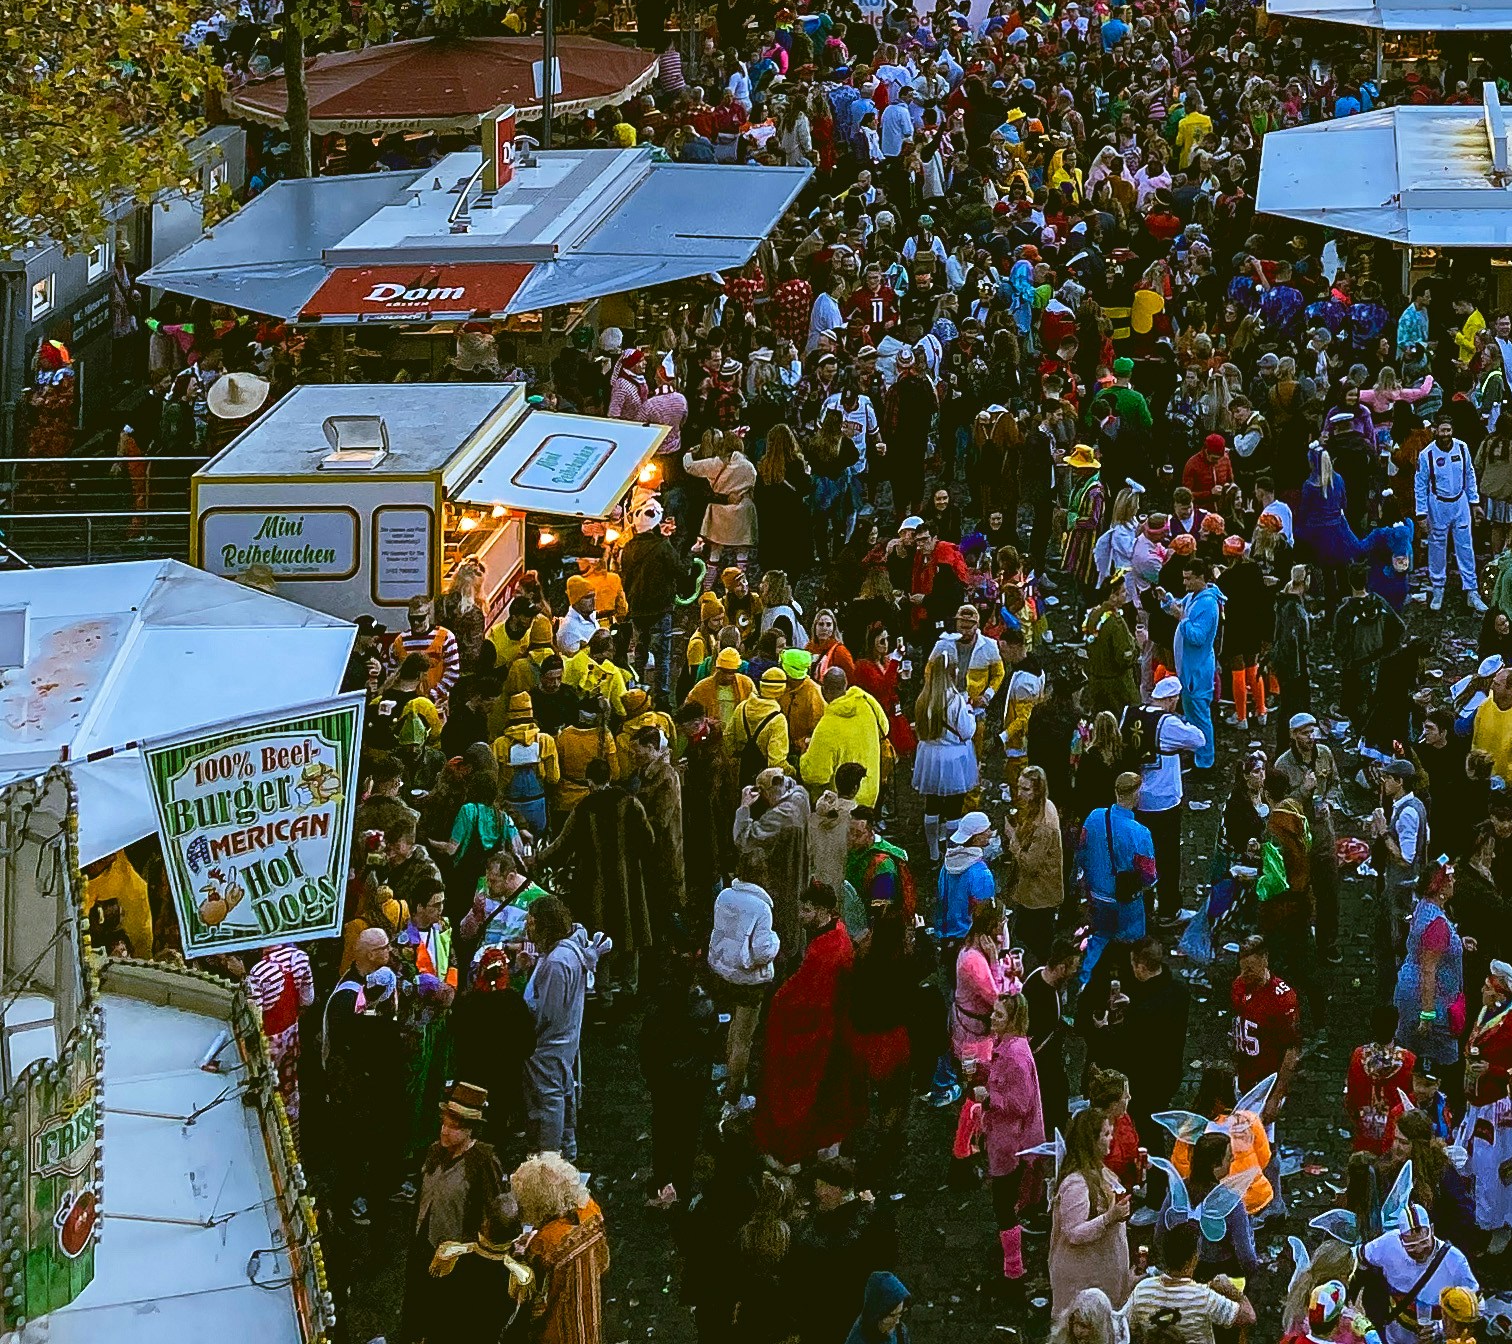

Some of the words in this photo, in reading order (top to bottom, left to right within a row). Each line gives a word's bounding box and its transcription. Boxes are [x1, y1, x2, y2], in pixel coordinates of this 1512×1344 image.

[362, 283, 466, 302] Dom
[871, 300, 884, 323] 11
[253, 514, 305, 541] Mini
[220, 543, 337, 568] Reibekuchen
[193, 751, 256, 787] 100%
[166, 773, 294, 840] Burger
[185, 812, 331, 874] AMERICAN
[239, 845, 305, 903] Hot
[253, 874, 339, 938] Dogs
